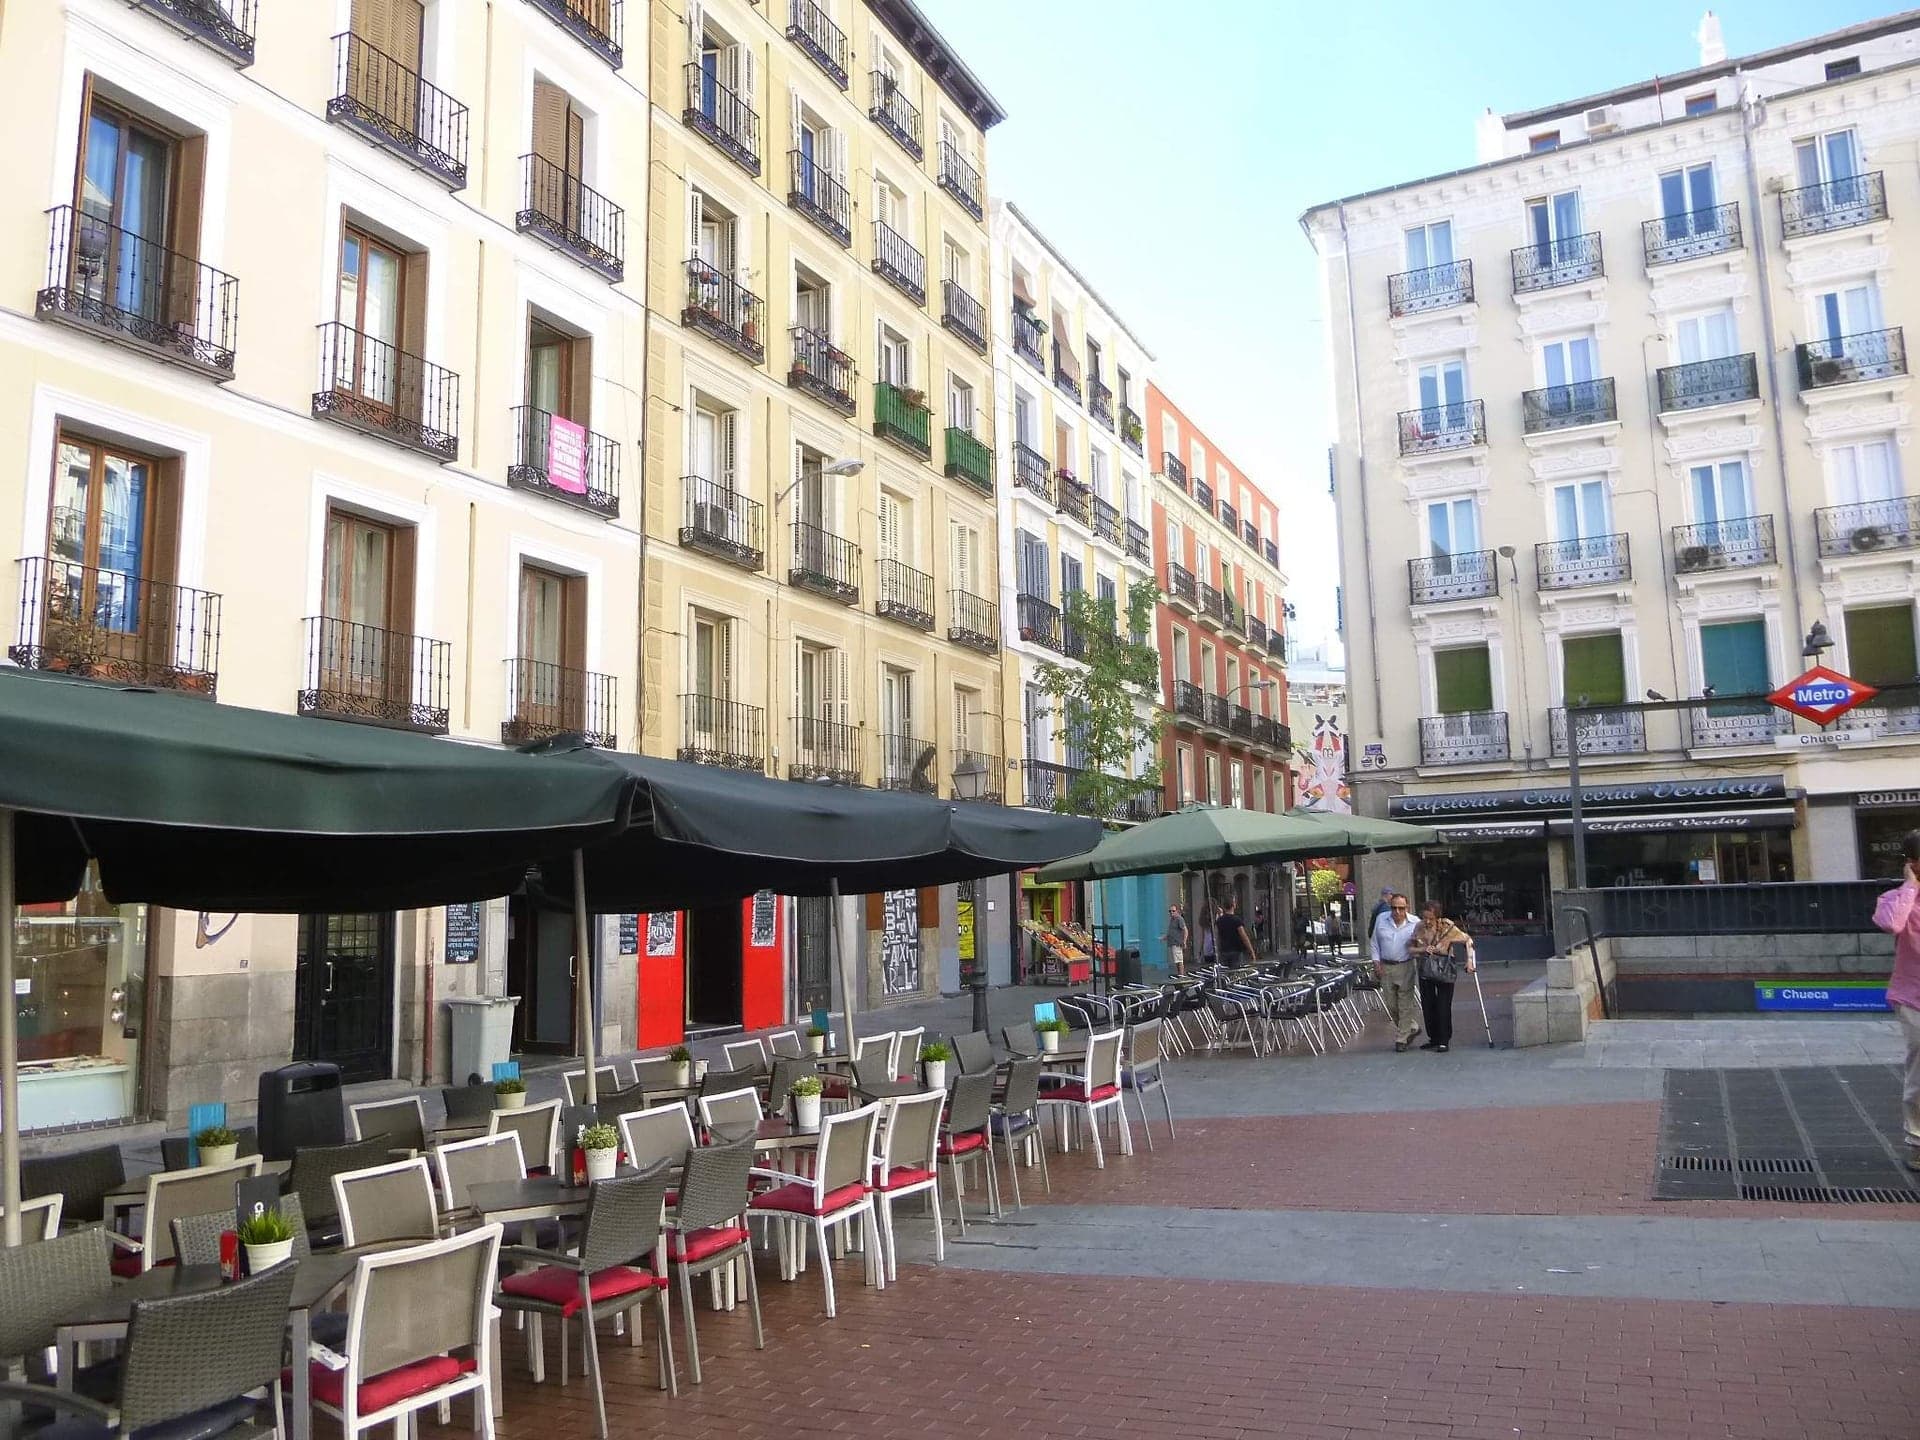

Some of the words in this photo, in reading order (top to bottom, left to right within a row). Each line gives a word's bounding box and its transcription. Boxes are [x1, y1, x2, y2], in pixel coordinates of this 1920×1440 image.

[1798, 689, 1846, 702] Metro
[1800, 733, 1850, 745] Chueca
[1648, 780, 1772, 798] Verdoy
[1782, 989, 1829, 999] Chueca
